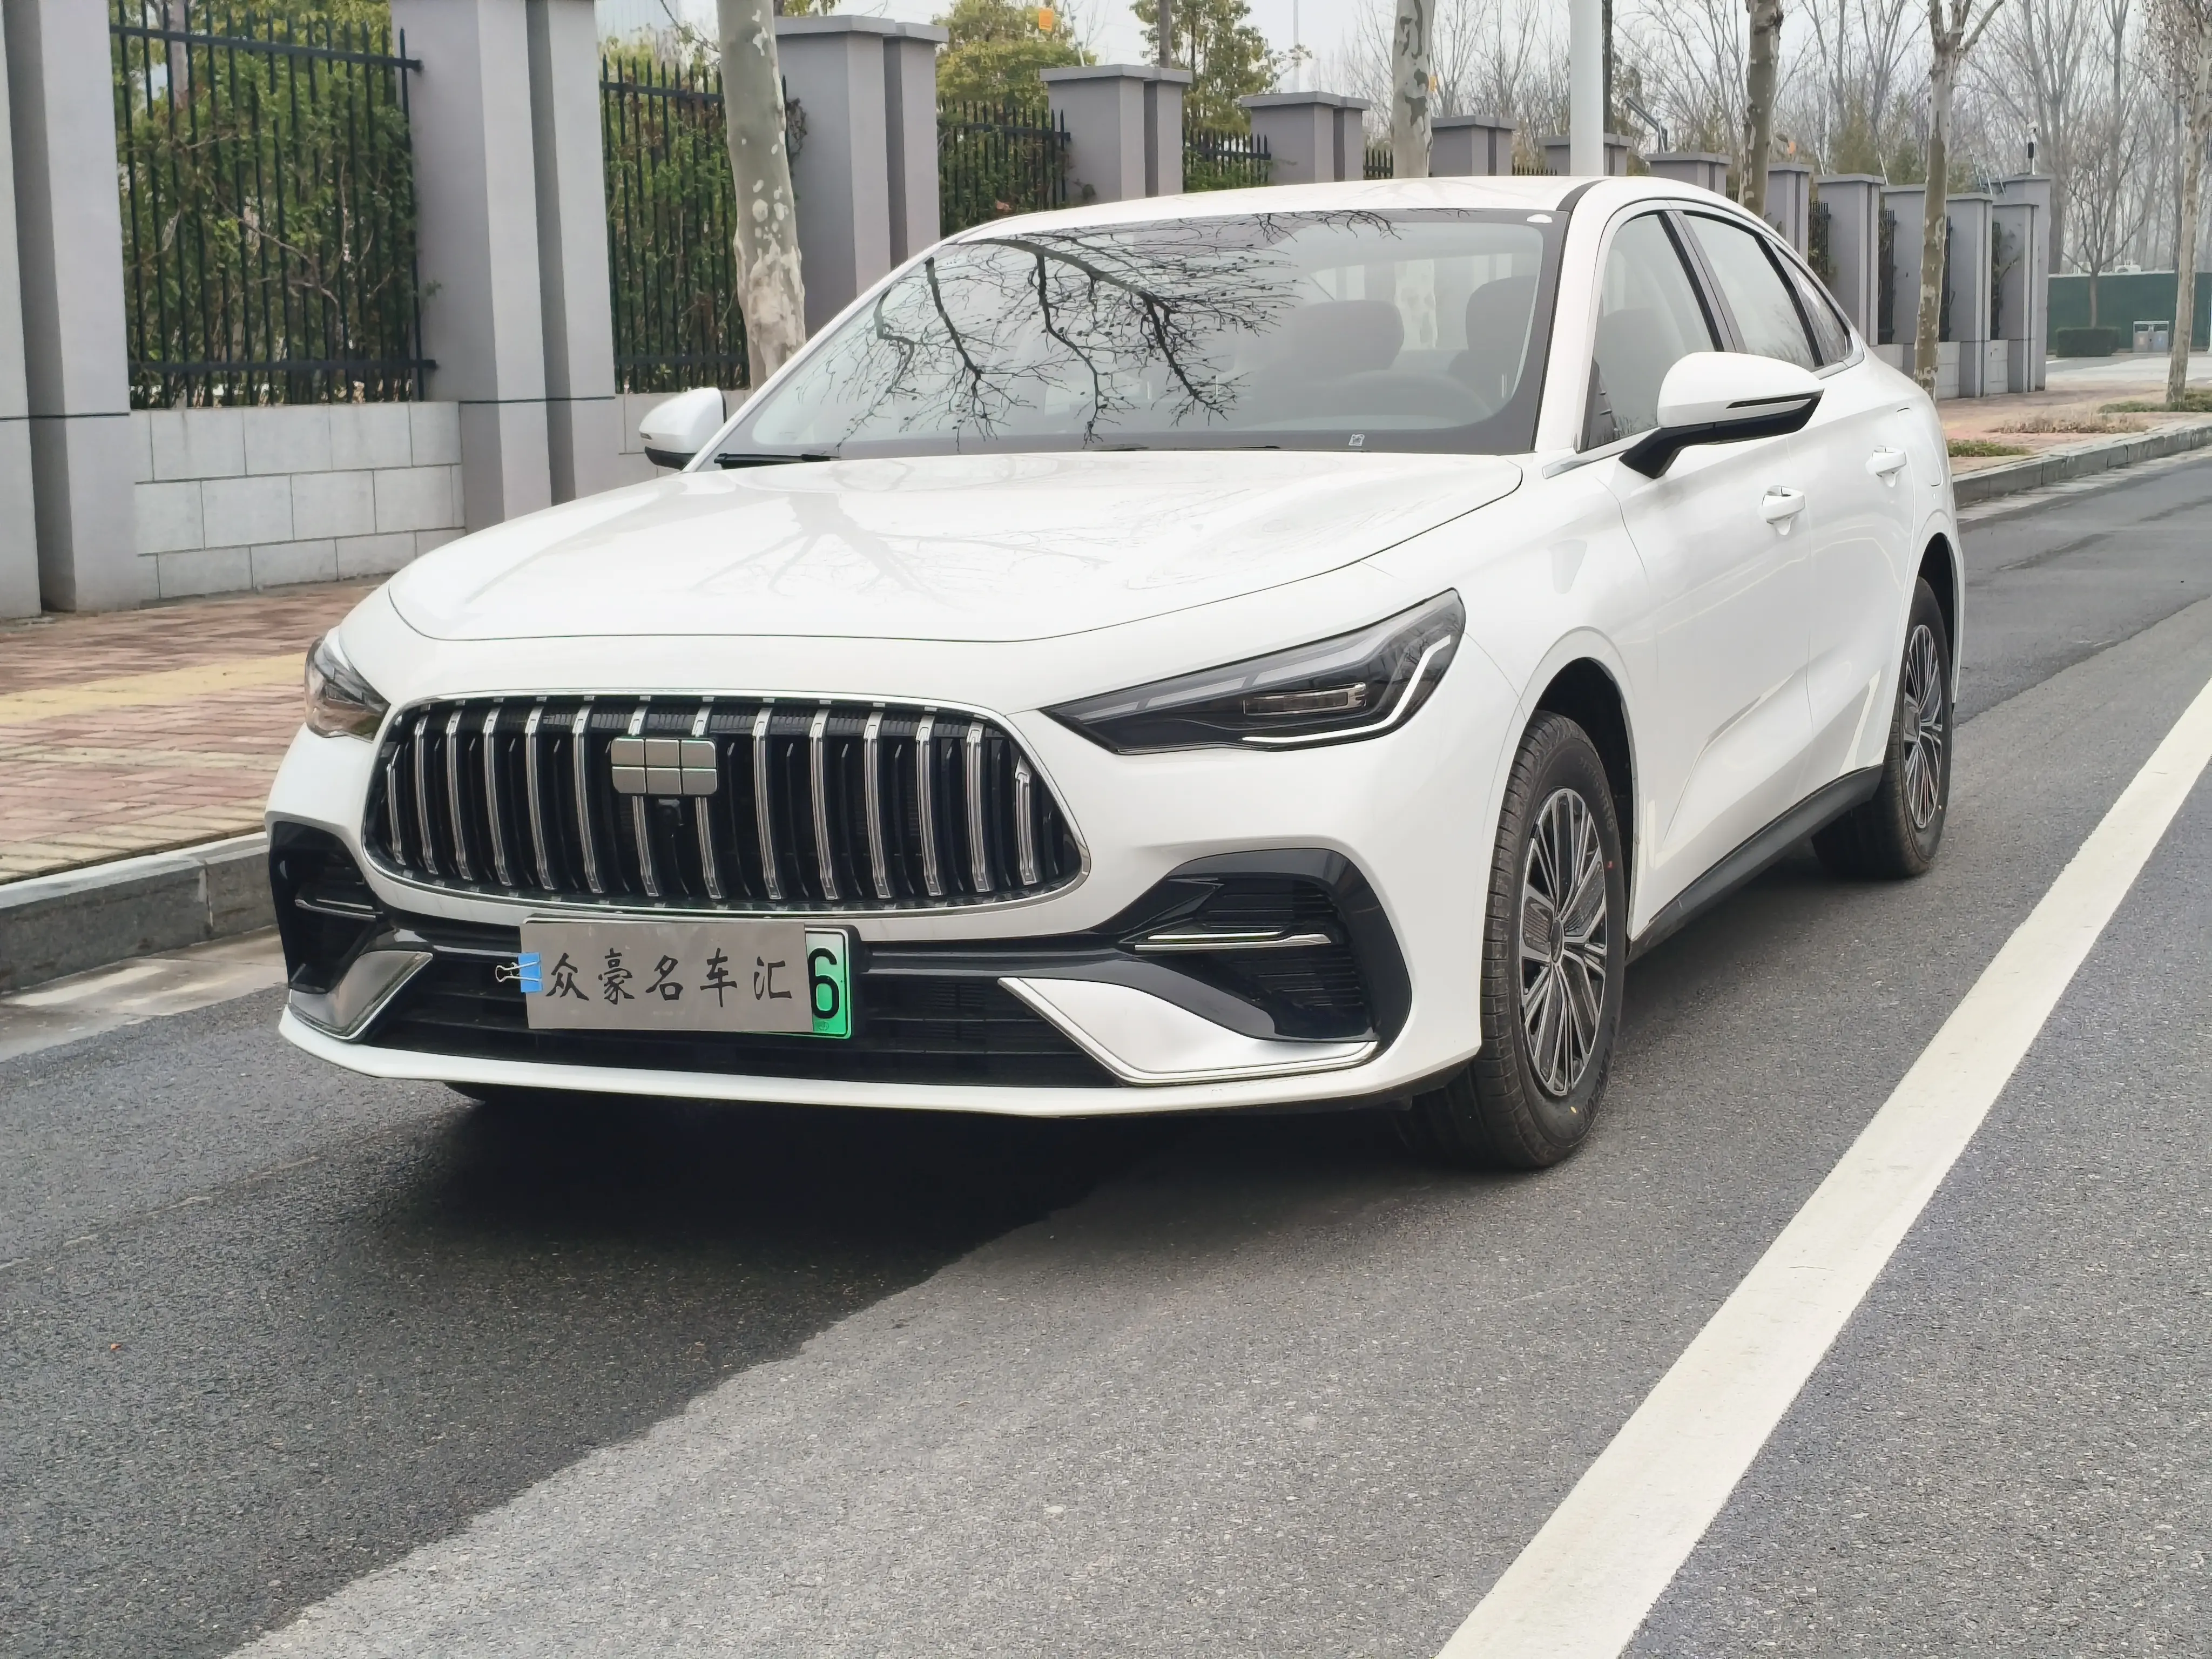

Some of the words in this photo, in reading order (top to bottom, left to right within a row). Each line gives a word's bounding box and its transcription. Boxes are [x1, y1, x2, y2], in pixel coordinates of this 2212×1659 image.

[545, 947, 792, 1008] 众豪名车汇
[807, 947, 840, 1019] 6
